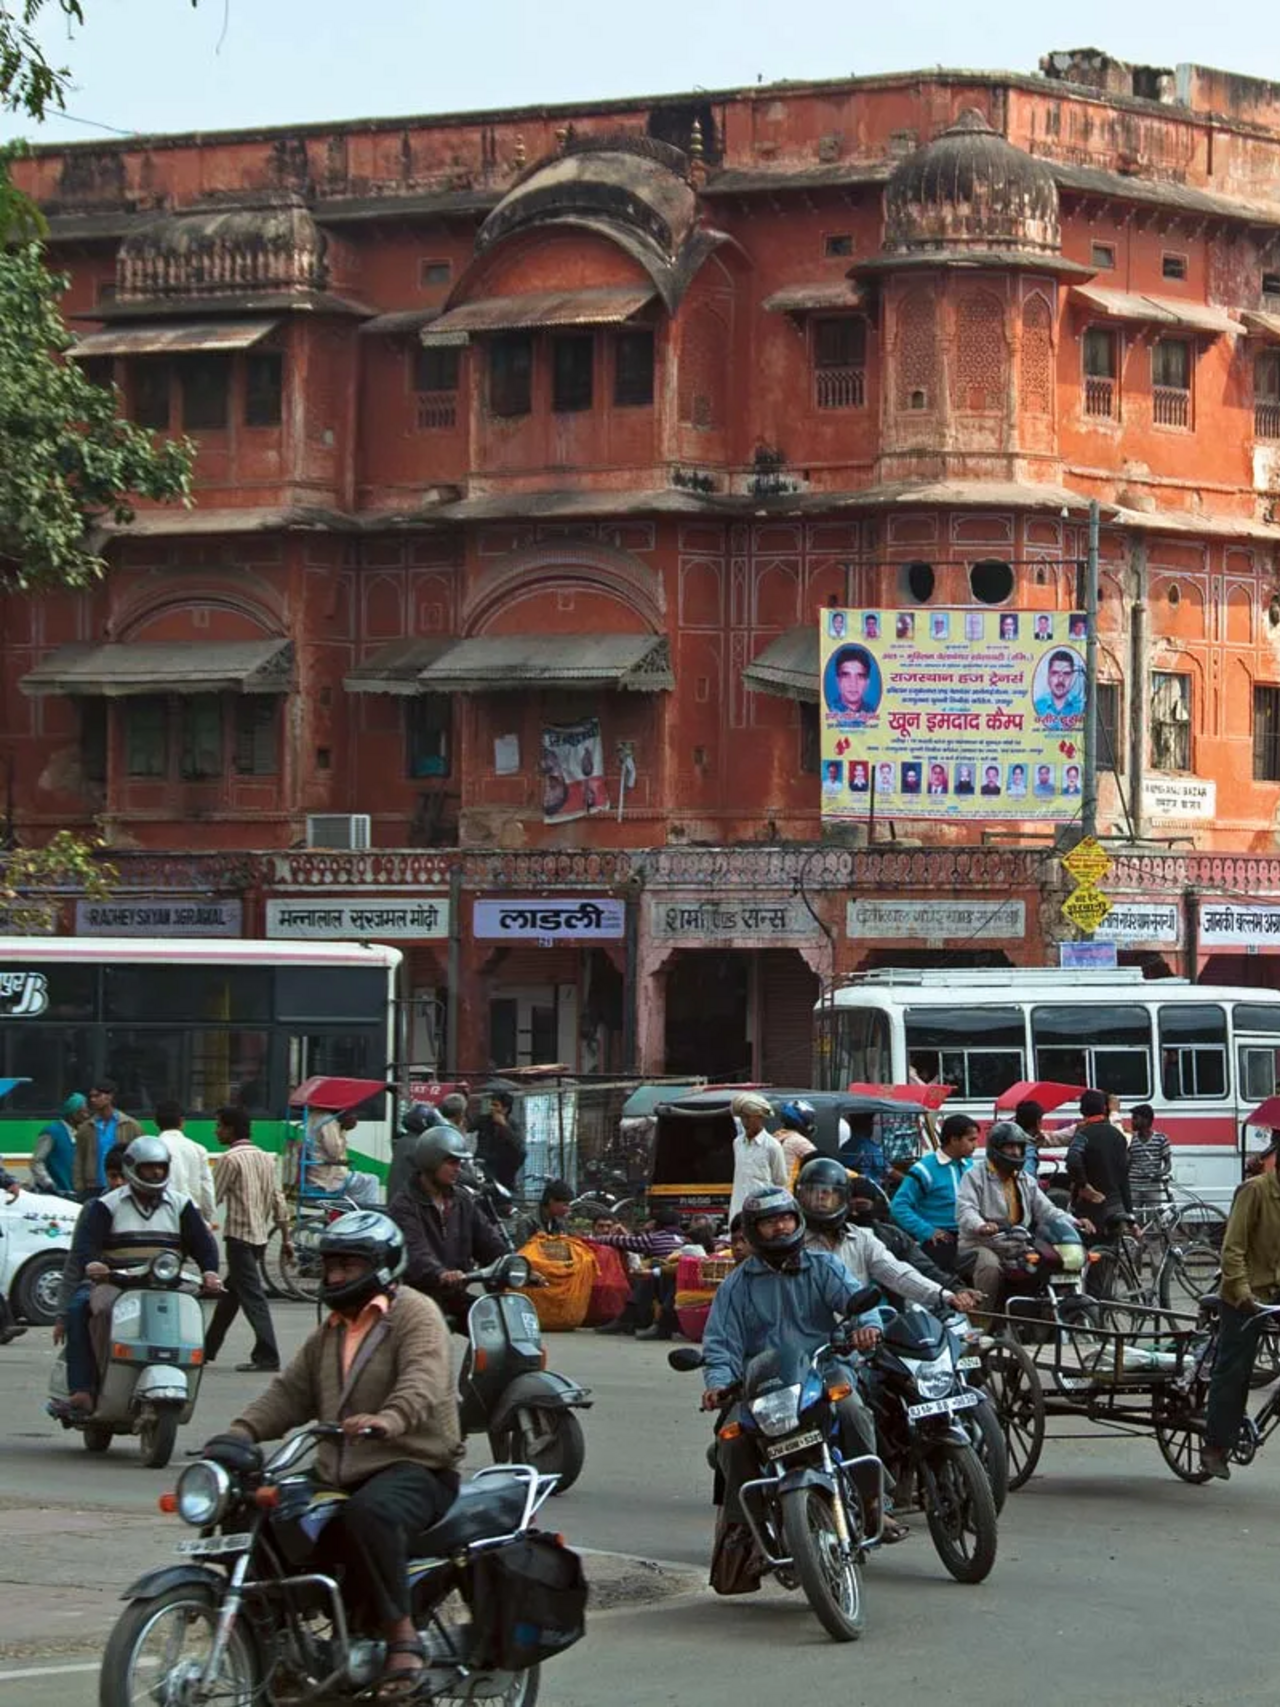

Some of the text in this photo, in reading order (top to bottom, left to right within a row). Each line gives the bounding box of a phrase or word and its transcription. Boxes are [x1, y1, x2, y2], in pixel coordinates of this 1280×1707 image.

[890, 672, 954, 684] राजस्थान
[888, 711, 921, 738] खून
[926, 712, 981, 732] इमदाद
[986, 707, 1025, 732] कैम्प
[278, 909, 345, 930] मन्नालाल
[349, 909, 409, 931] सूरजमल
[499, 902, 605, 931] लाडली
[741, 907, 787, 929] सन्स
[1203, 906, 1235, 933] जानकी
